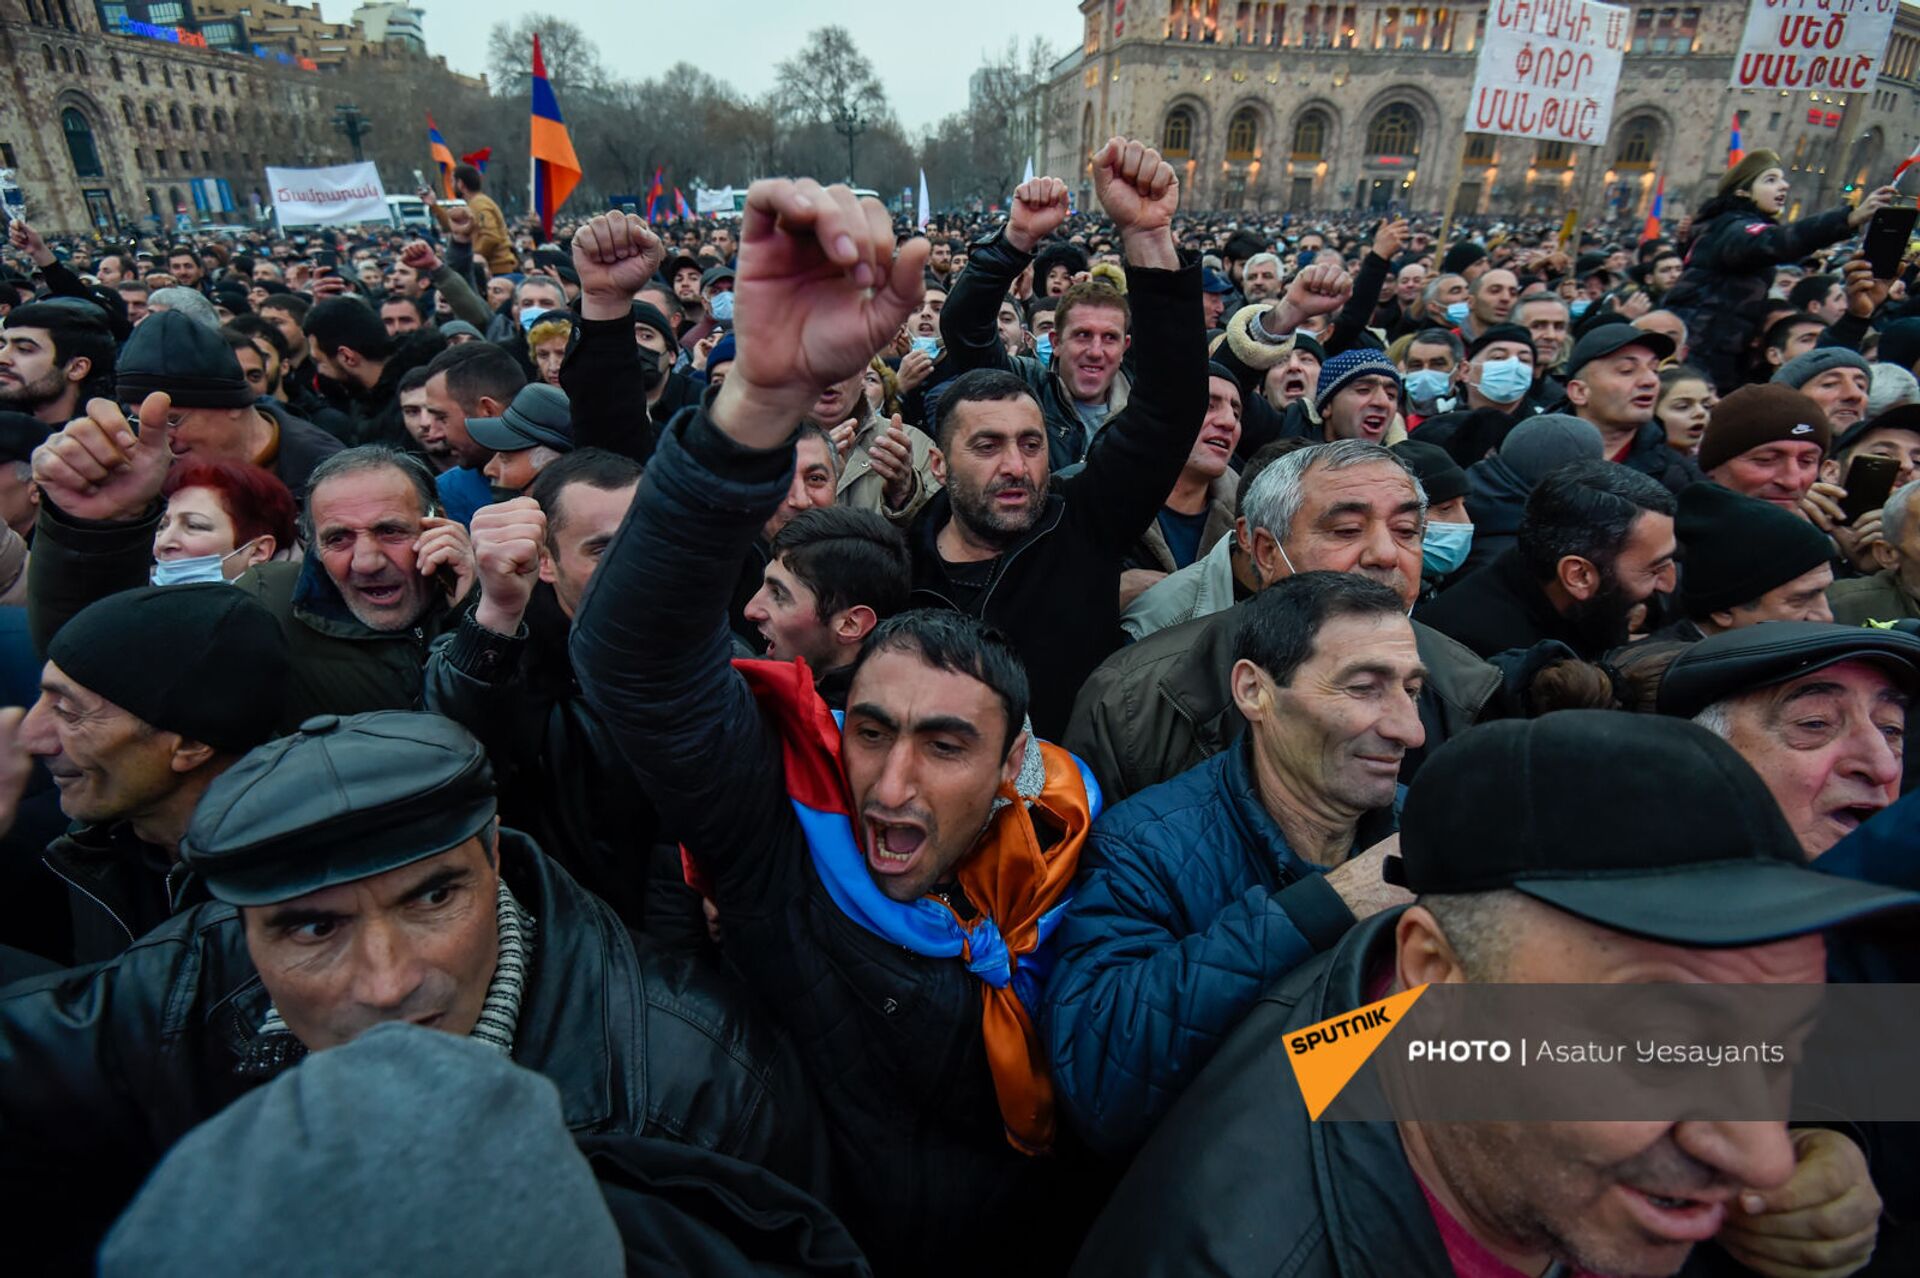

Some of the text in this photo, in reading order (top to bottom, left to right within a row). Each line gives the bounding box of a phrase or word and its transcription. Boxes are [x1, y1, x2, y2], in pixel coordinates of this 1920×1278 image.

[1779, 13, 1847, 49] ՄԵԾ
[1516, 41, 1593, 91] ՓՈՔՐ
[1739, 53, 1875, 89] ՄԱՆԹԱՇ
[1476, 87, 1598, 140] ՄԱՆԹԱՇ
